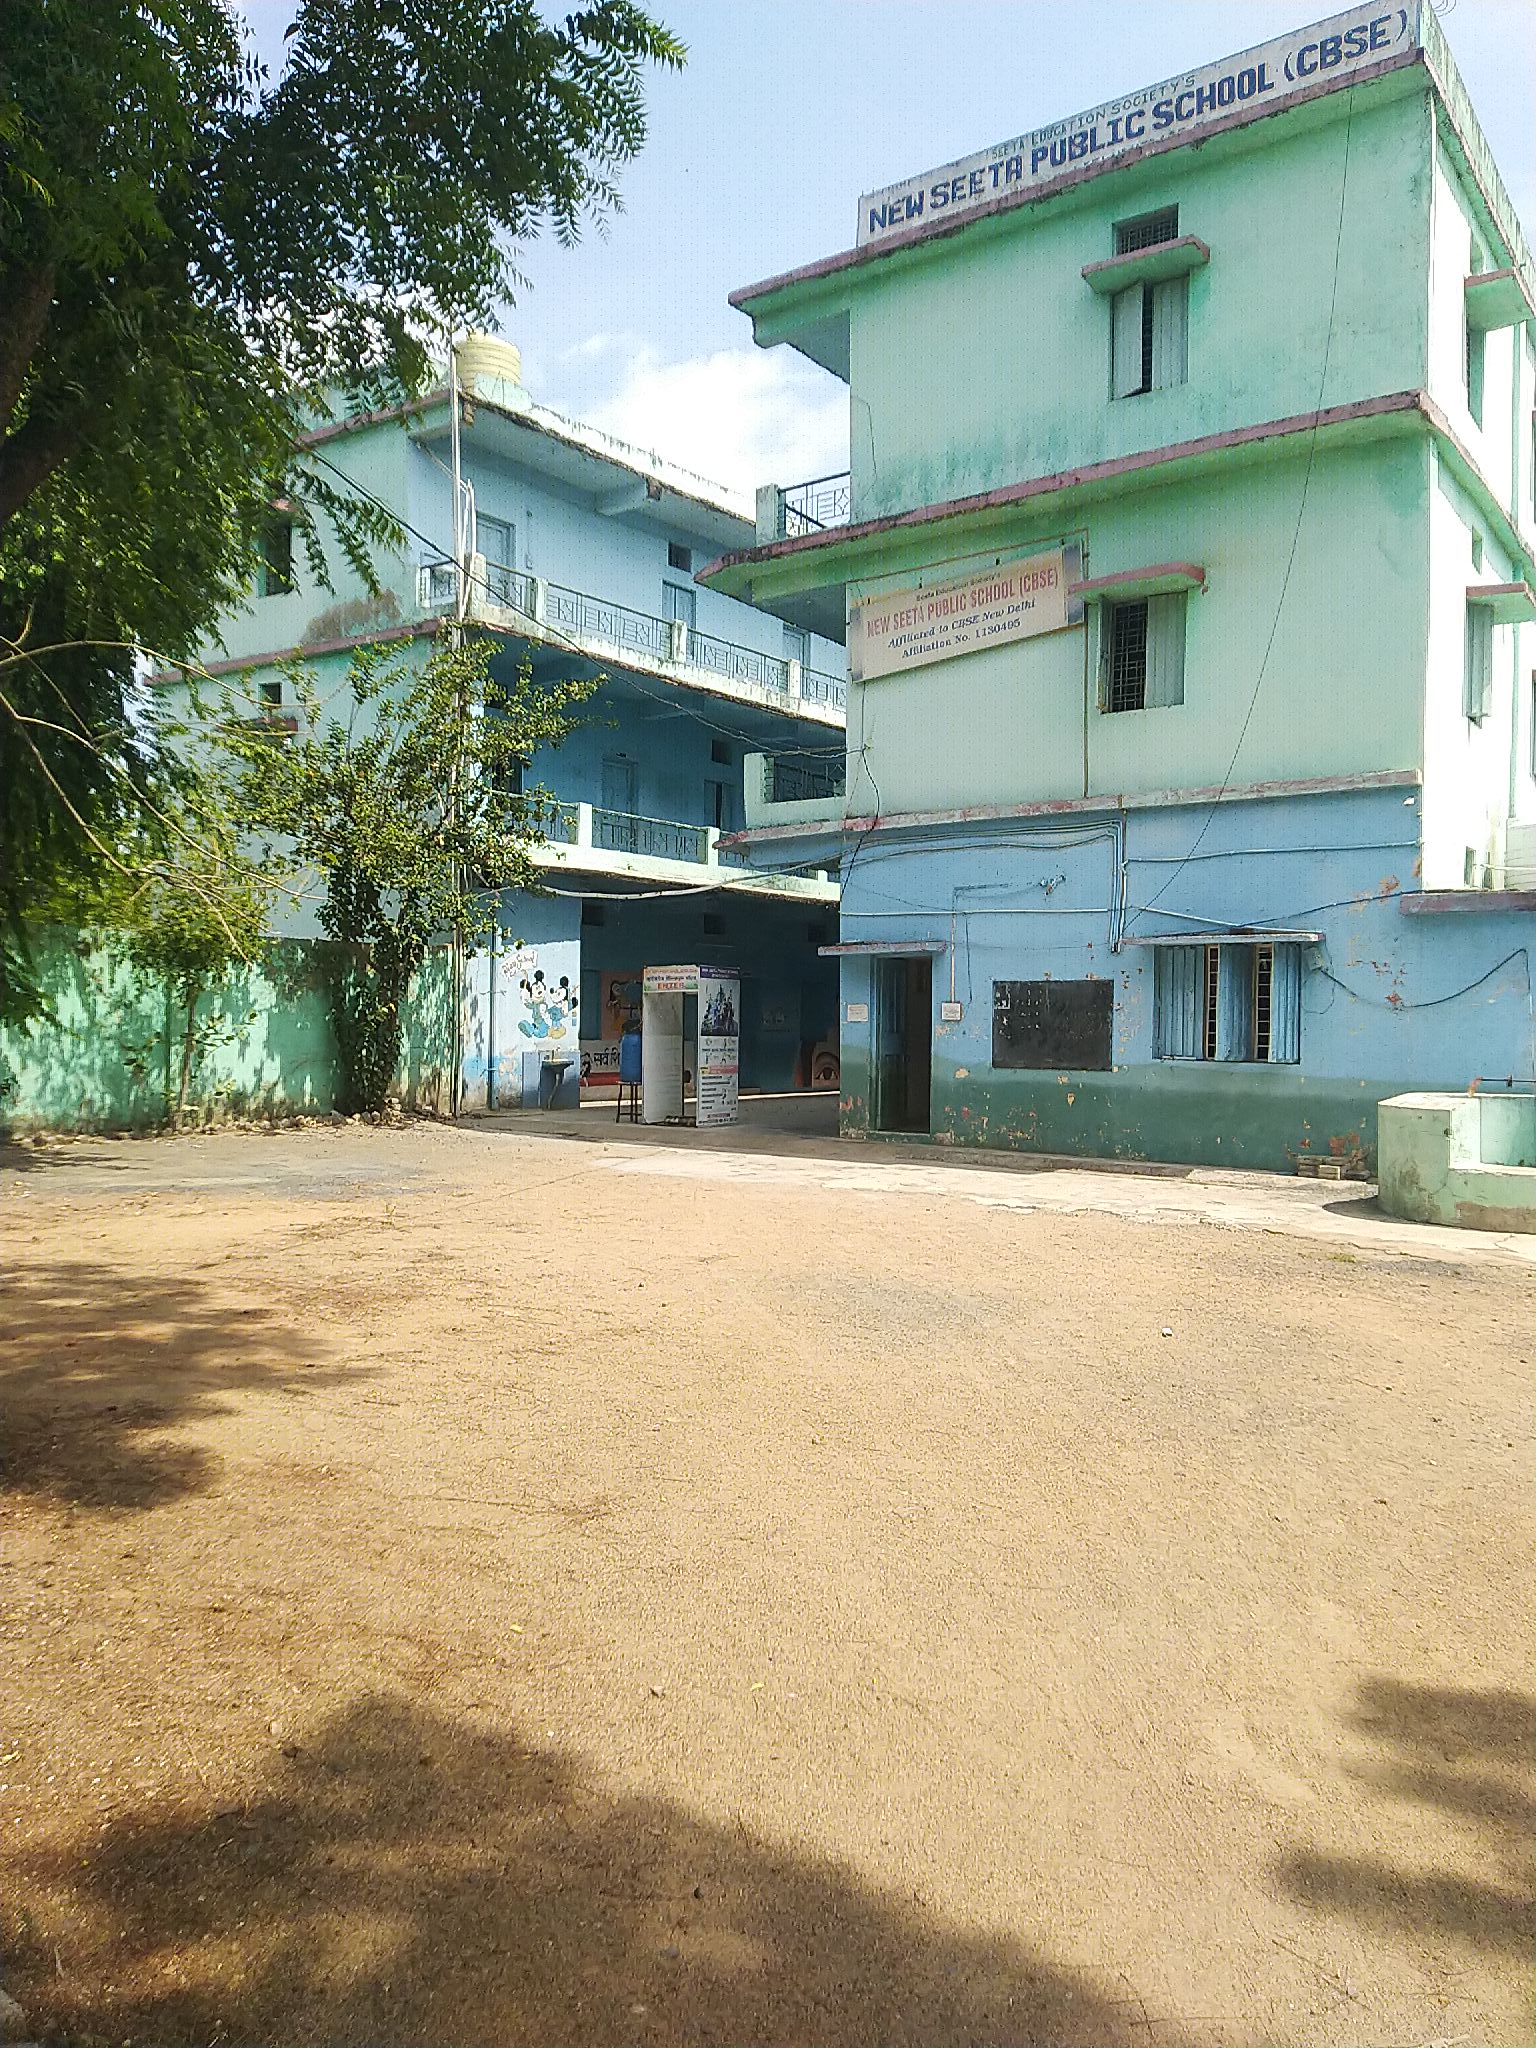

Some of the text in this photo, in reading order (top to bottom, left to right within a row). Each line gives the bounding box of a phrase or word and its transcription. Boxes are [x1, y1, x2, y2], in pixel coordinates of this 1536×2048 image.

[868, 9, 1407, 234] NEW SEETA PUBLIC SCHOOL (CBSE)
[1031, 109, 1106, 146] EDUCATION
[1111, 75, 1196, 115] SOCIETY'S
[867, 566, 1059, 638] NEW SEETA PUBLIC SCHOOL (CBSE)
[888, 597, 1036, 648] Affiliated to CBSE New Delhi
[902, 638, 952, 659] Affiliation
[955, 634, 971, 645] No.
